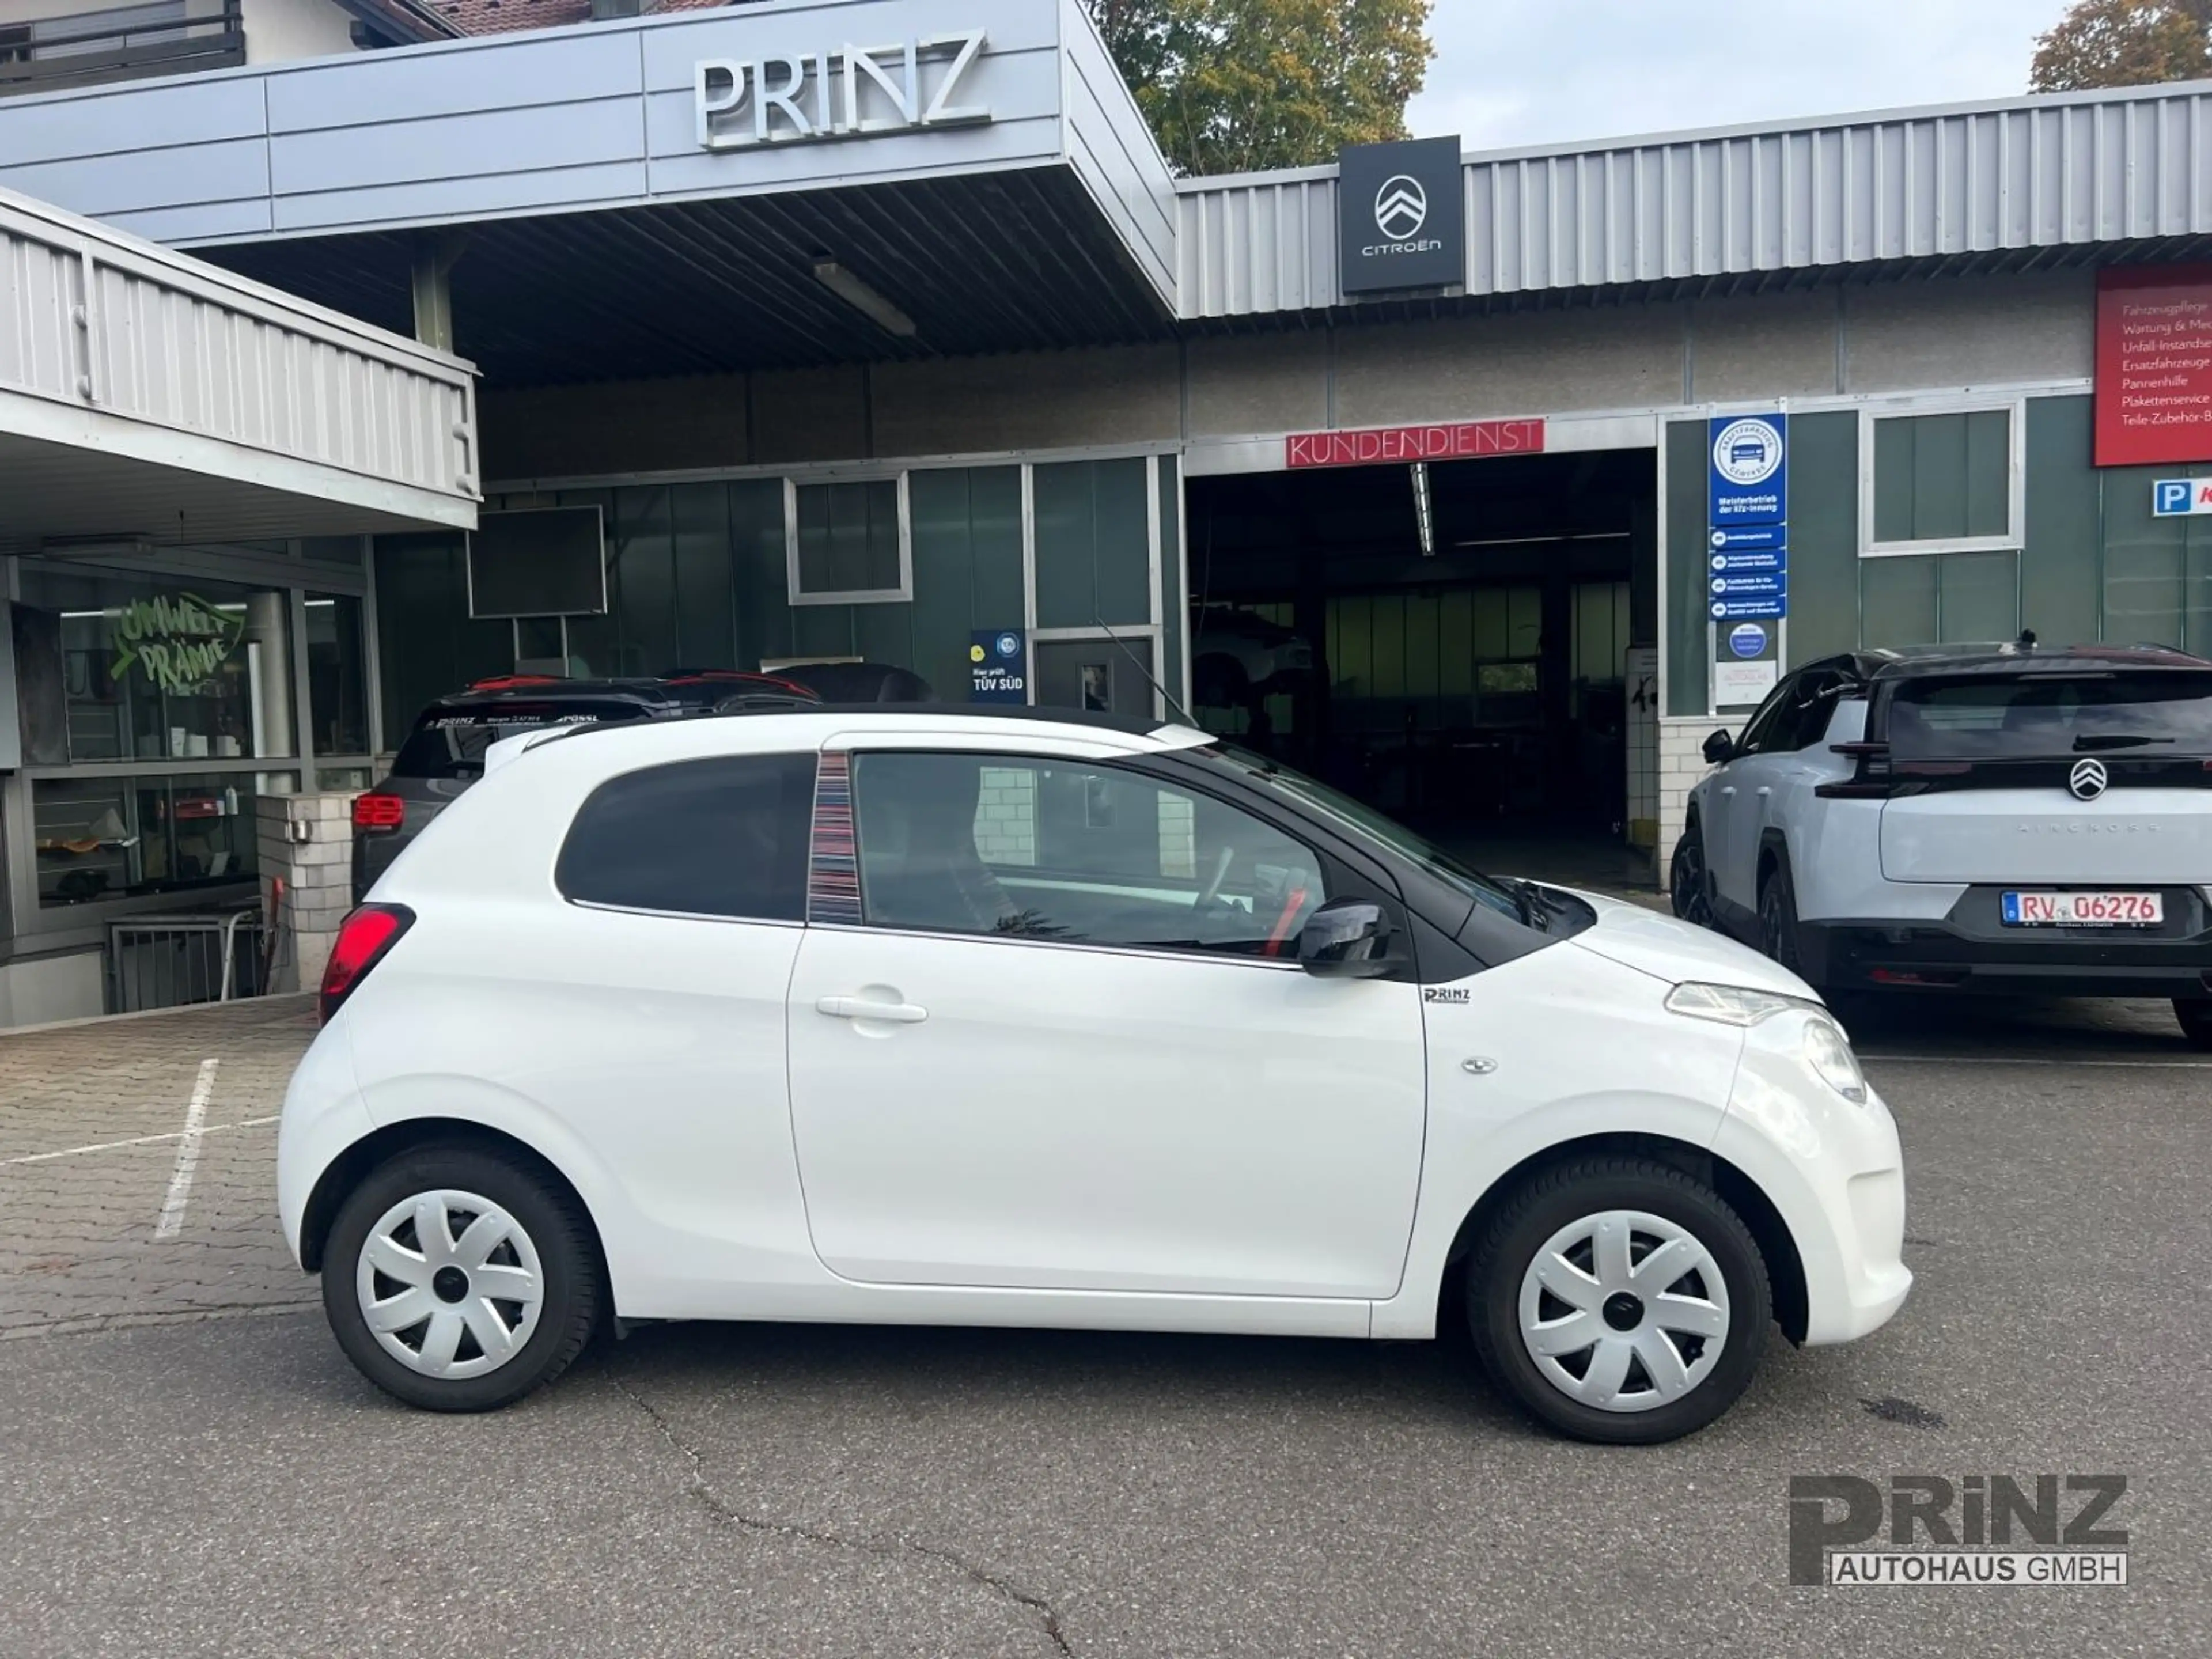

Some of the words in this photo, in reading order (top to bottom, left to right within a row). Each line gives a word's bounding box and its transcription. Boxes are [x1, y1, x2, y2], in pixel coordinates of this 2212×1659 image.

[695, 27, 991, 147] PRINZ
[2123, 301, 2208, 316] Fahrzeugpflege
[2123, 323, 2171, 336] Wartung
[2175, 320, 2186, 331] &
[2123, 357, 2211, 372] Ersatzfahrzeuge
[2123, 374, 2188, 390] Pannenhilfe
[2122, 393, 2210, 408] Plakettenservice
[1291, 422, 1540, 464] KUNDENDIENST
[2164, 485, 2186, 510] P
[973, 676, 997, 691] TÜV
[999, 675, 1023, 690] SÜD
[2024, 897, 2055, 919] RV
[2075, 896, 2154, 919] 06276
[1424, 988, 1470, 1002] PRINZ
